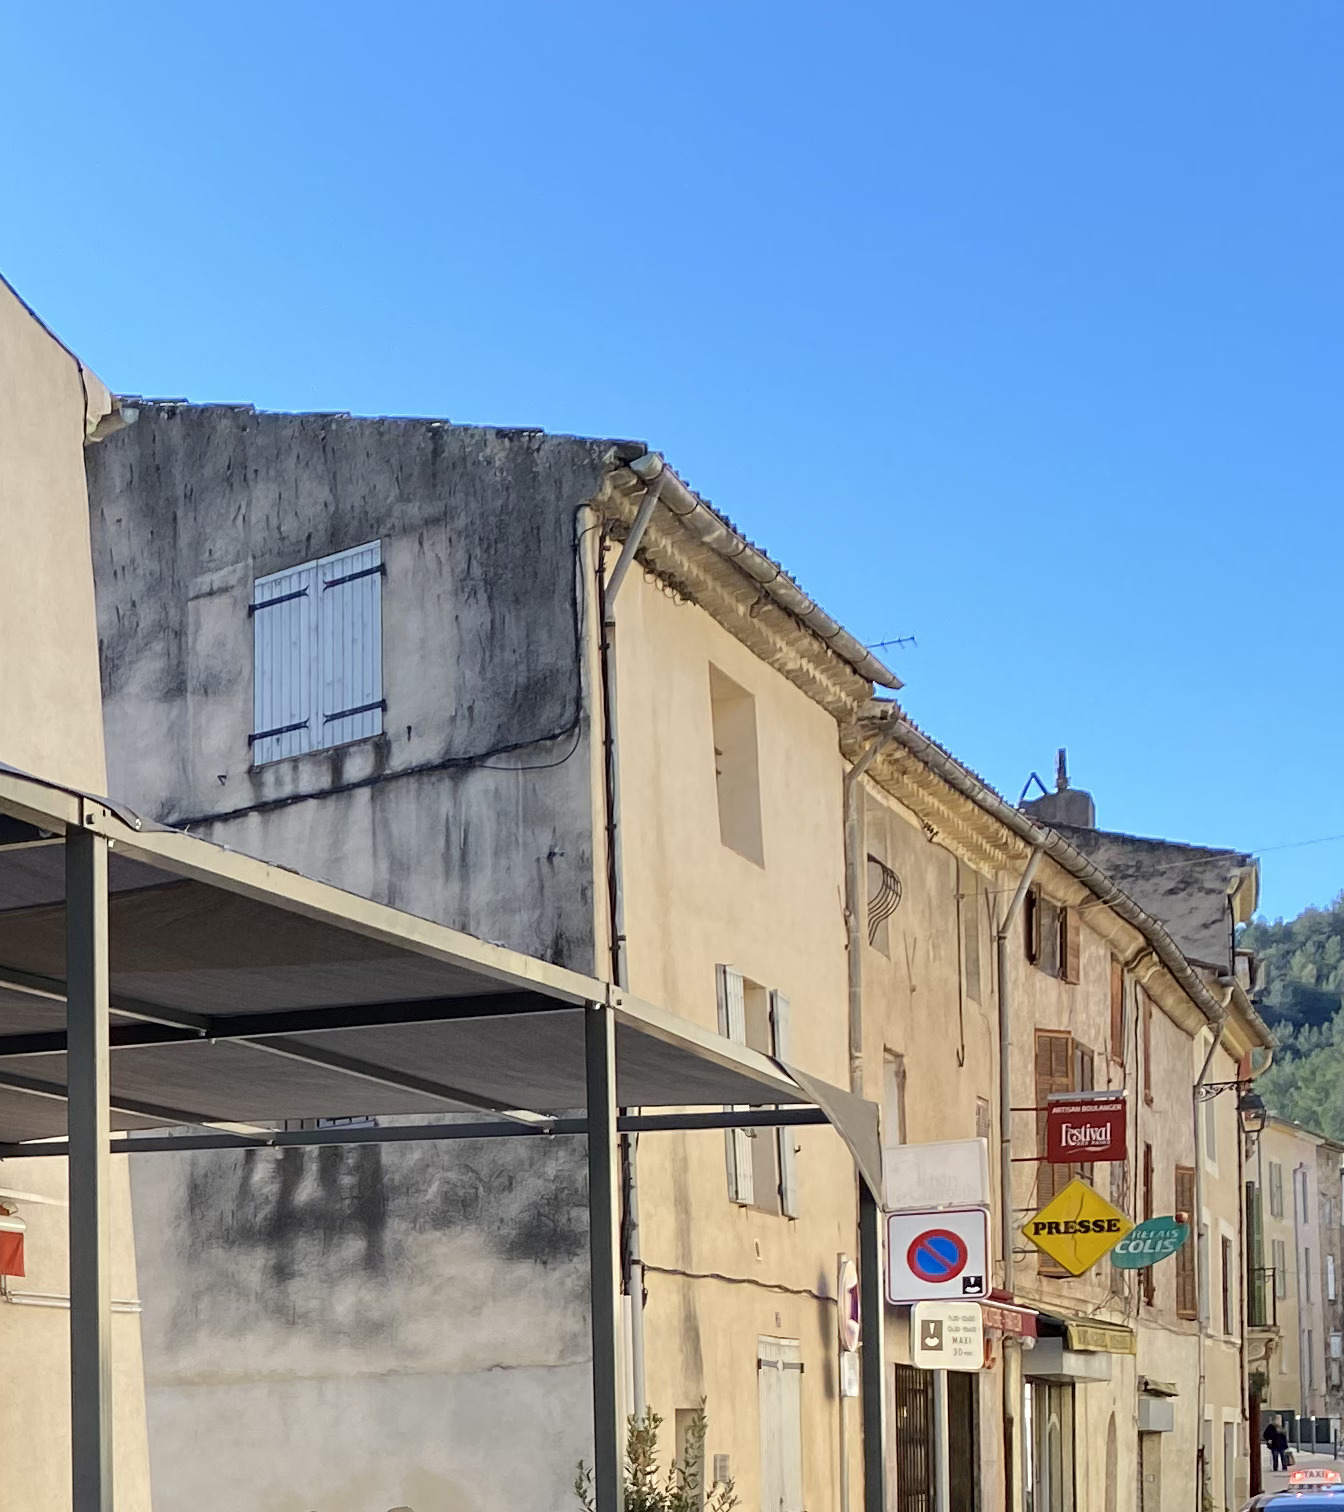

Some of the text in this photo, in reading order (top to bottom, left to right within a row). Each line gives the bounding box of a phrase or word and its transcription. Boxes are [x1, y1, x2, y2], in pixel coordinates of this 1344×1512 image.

[1061, 1122, 1111, 1147] Festival
[1033, 1218, 1121, 1236] PRESSE
[1131, 1229, 1180, 1239] RELAIS
[1114, 1238, 1177, 1254] COLIS
[1304, 1470, 1326, 1479] TAXI
